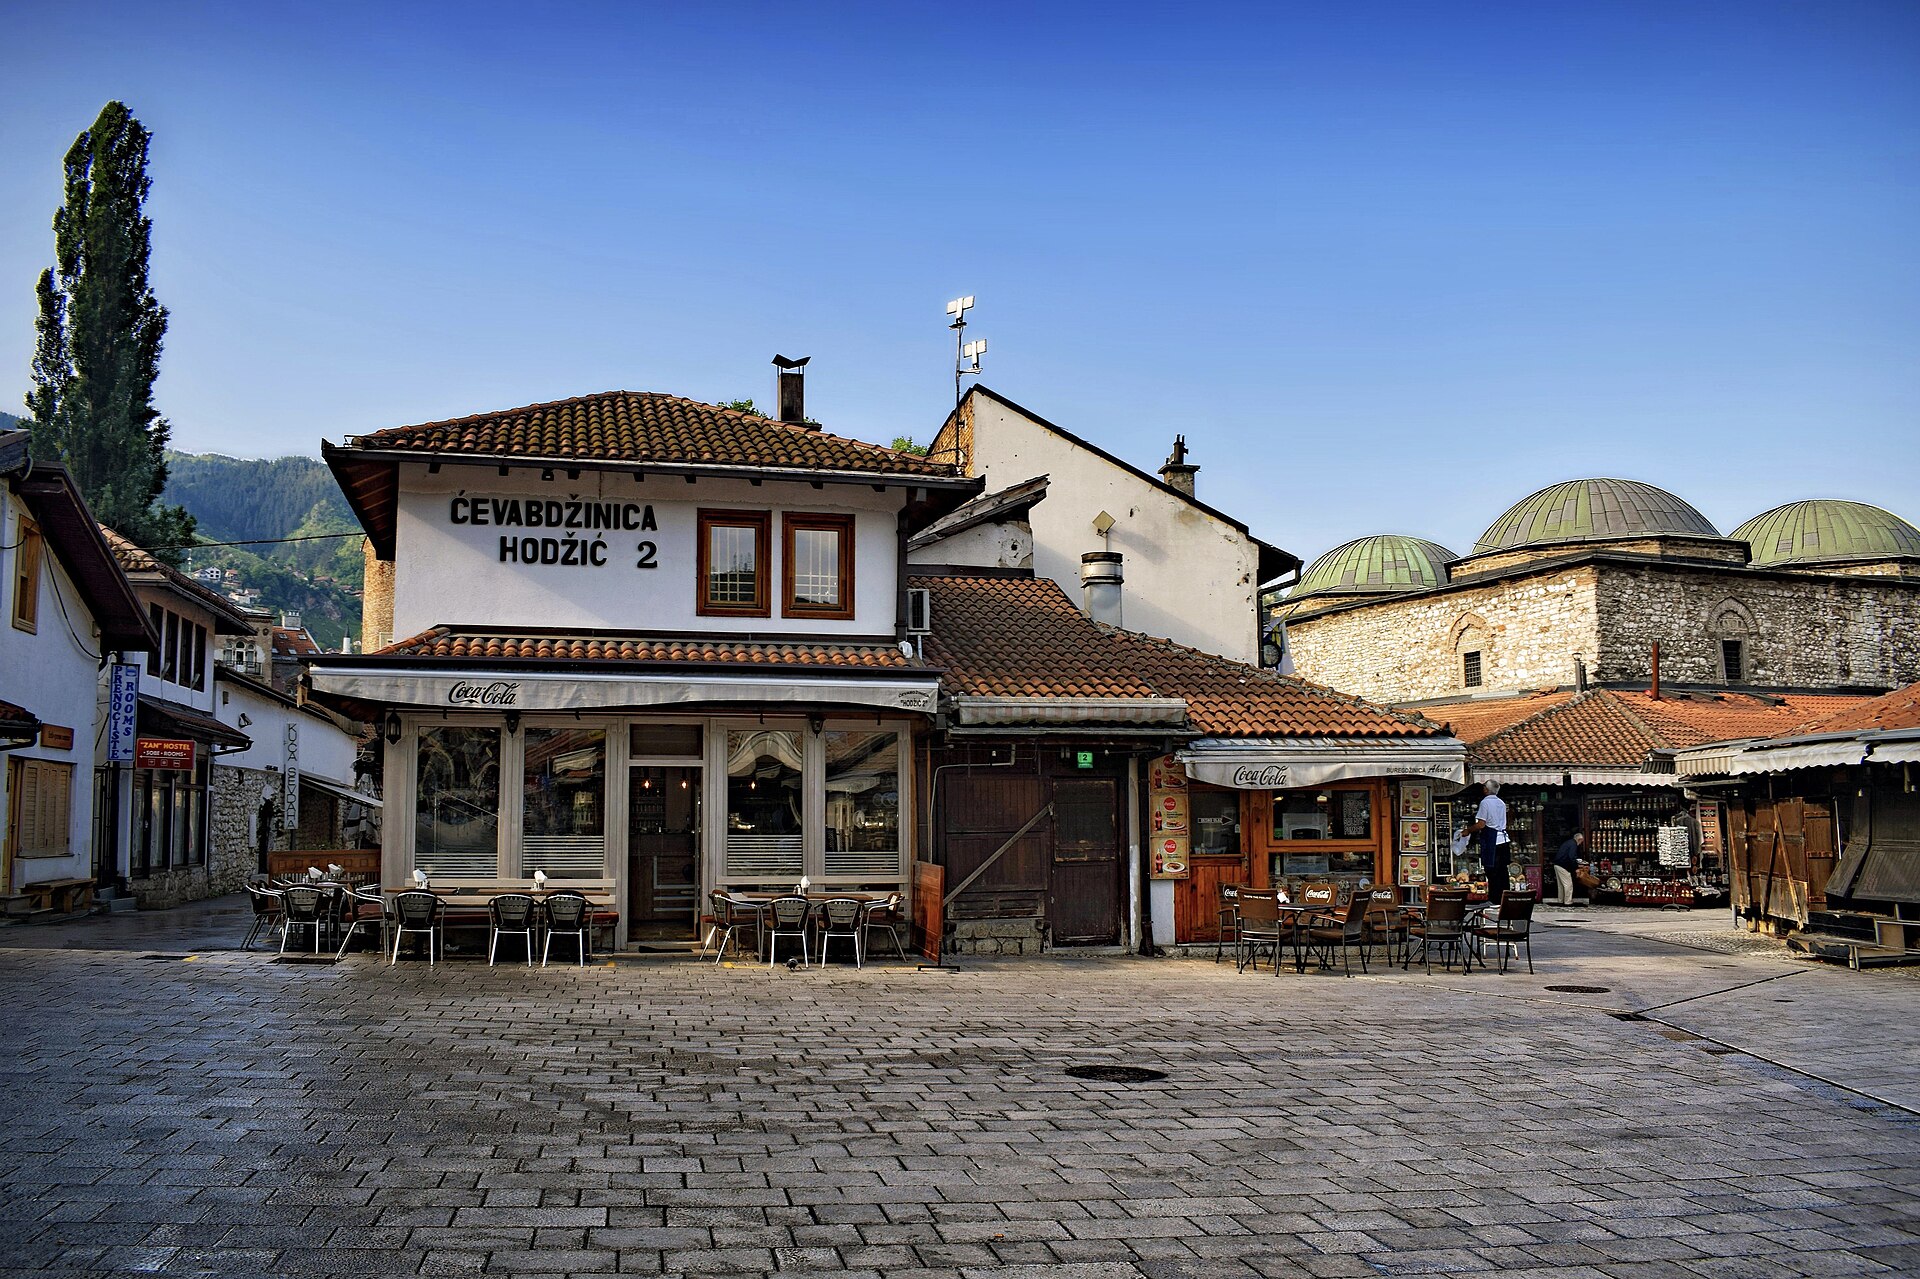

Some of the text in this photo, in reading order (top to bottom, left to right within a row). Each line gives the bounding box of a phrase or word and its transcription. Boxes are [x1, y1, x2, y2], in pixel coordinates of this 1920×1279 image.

[450, 489, 658, 531] ĆEVABDŽINICA
[499, 531, 659, 569] HODŽIĆ 2
[122, 681, 135, 737] ROOMS
[448, 681, 520, 705] Coca-Cola
[163, 743, 191, 751] HOSTEL
[1233, 765, 1289, 786] Coca-Cola
[286, 767, 297, 829] SEVDAHA
